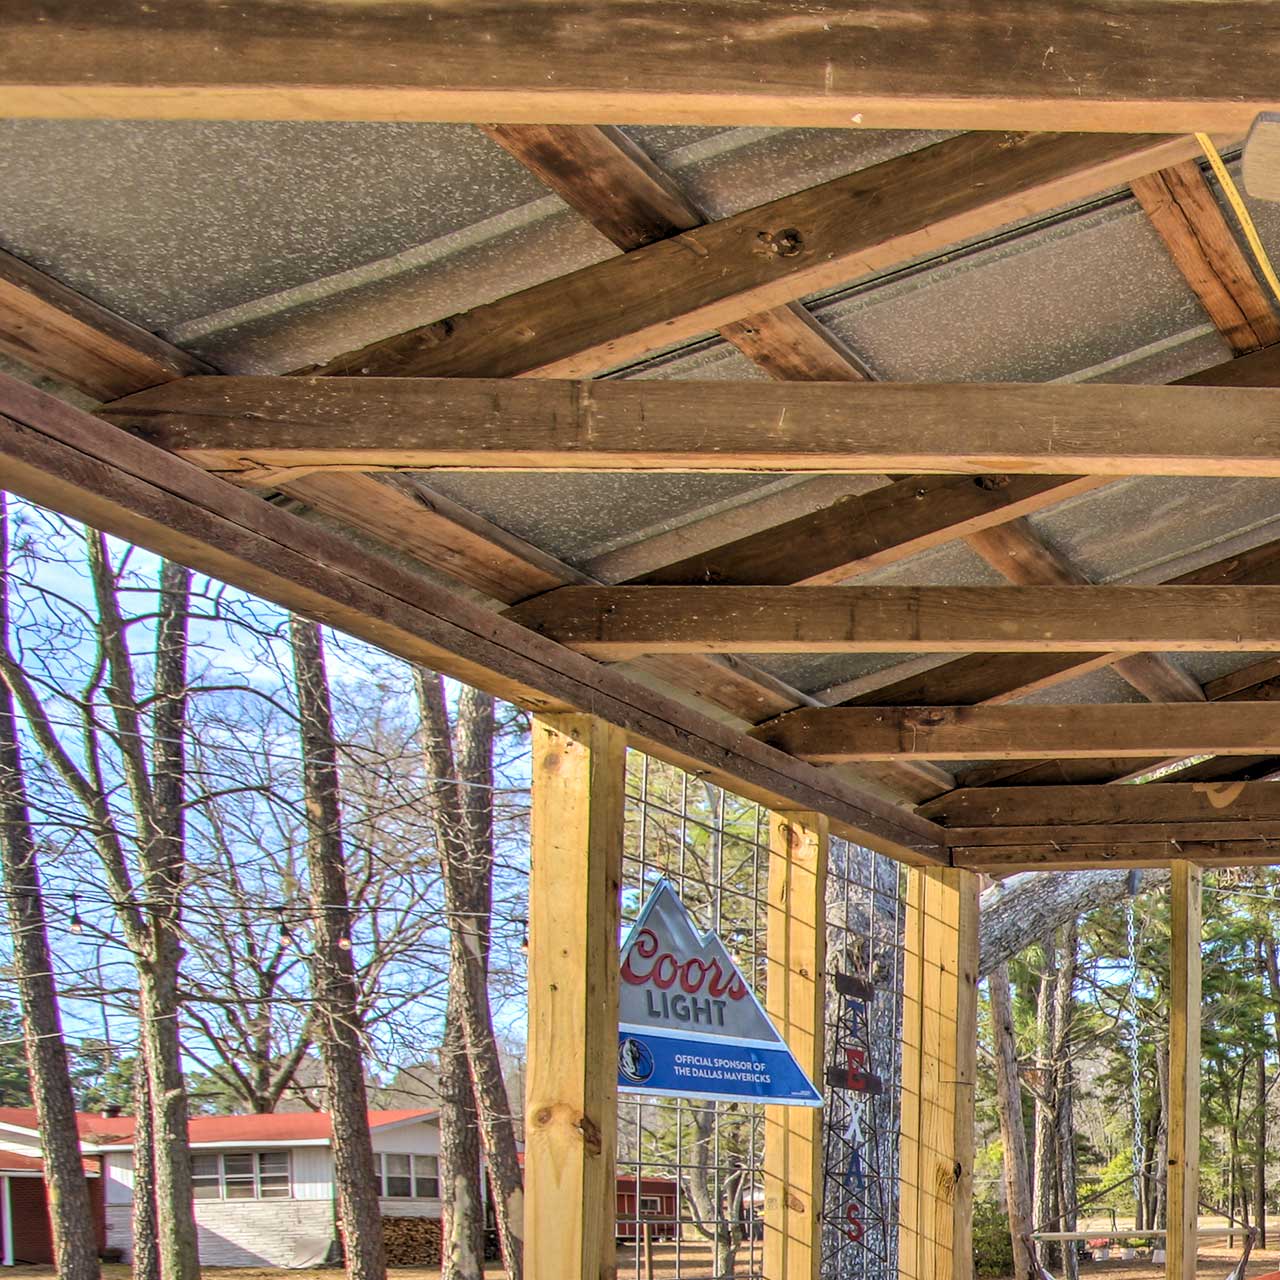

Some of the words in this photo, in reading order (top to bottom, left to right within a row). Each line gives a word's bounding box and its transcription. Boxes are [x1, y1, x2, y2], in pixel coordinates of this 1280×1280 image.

[620, 928, 749, 1000] Coors
[646, 989, 727, 1027] LIGHT
[674, 1066, 686, 1077] THE
[686, 1067, 723, 1080] DALLAS
[723, 1070, 771, 1084] MAVERICKS
[675, 1054, 713, 1069] OFFICIAL
[714, 1057, 753, 1071] SPONSOR
[754, 1061, 767, 1072] OF
